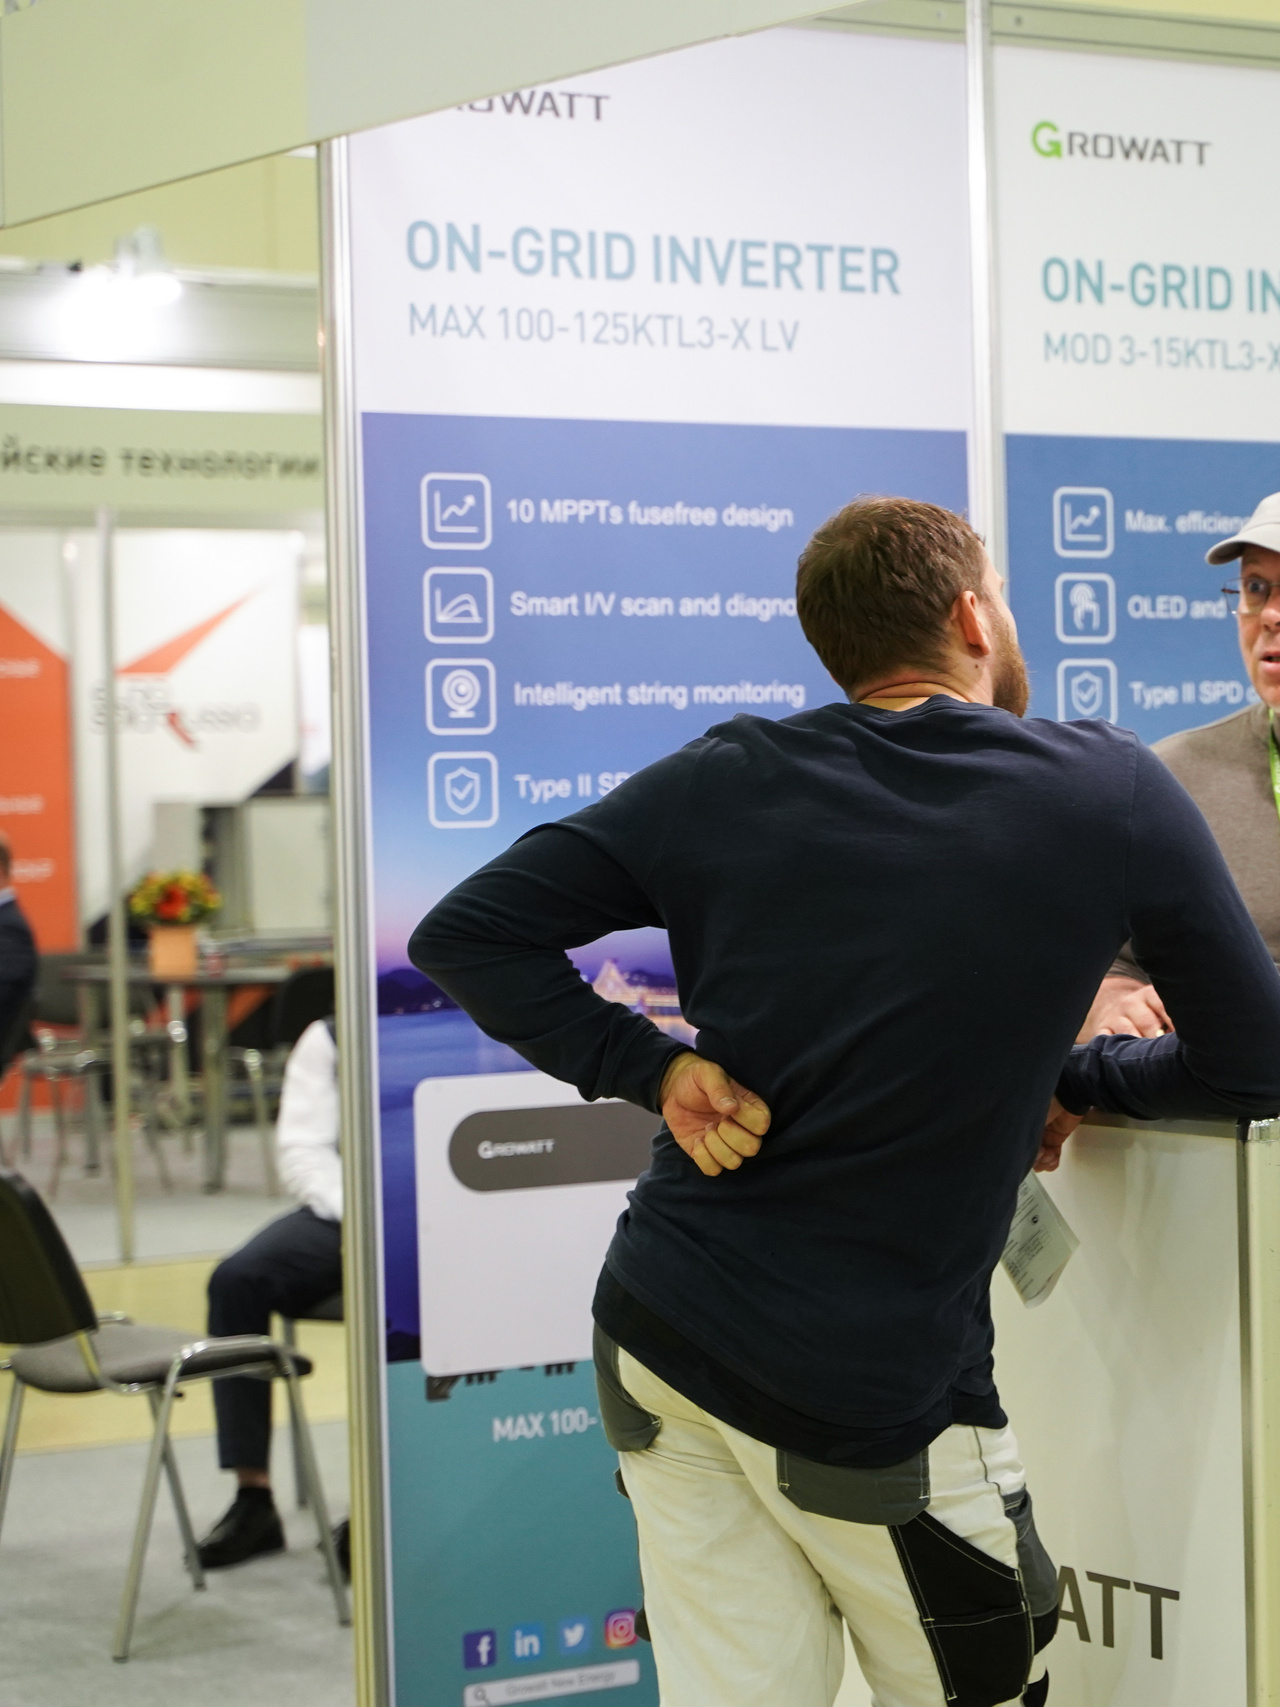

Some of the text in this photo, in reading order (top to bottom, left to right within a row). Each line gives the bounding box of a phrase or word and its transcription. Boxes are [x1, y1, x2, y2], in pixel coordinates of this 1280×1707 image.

[457, 89, 611, 121] WATT
[1031, 121, 1212, 166] GROWATT
[406, 219, 902, 296] ON-GRID INVERTER
[1042, 256, 1233, 312] ON-GRID
[408, 302, 800, 353] MAX 100-125KTL3-X LV
[1043, 331, 1113, 365] MOD
[507, 498, 794, 533] 10 MPPTs fusefree design
[1125, 509, 1250, 534] Max. efficien
[510, 590, 579, 617] Smart
[621, 596, 674, 617] scan
[679, 592, 721, 617] and
[725, 592, 798, 622] diagno
[1127, 594, 1228, 619] OLED and
[514, 680, 806, 711] Intelligent string monitoring
[1129, 681, 1179, 709] Type
[1198, 680, 1244, 705] SPD
[514, 773, 571, 804] Type
[577, 773, 592, 798] II
[492, 1406, 600, 1443] MAX 100-
[1056, 1565, 1180, 1660] ATT
